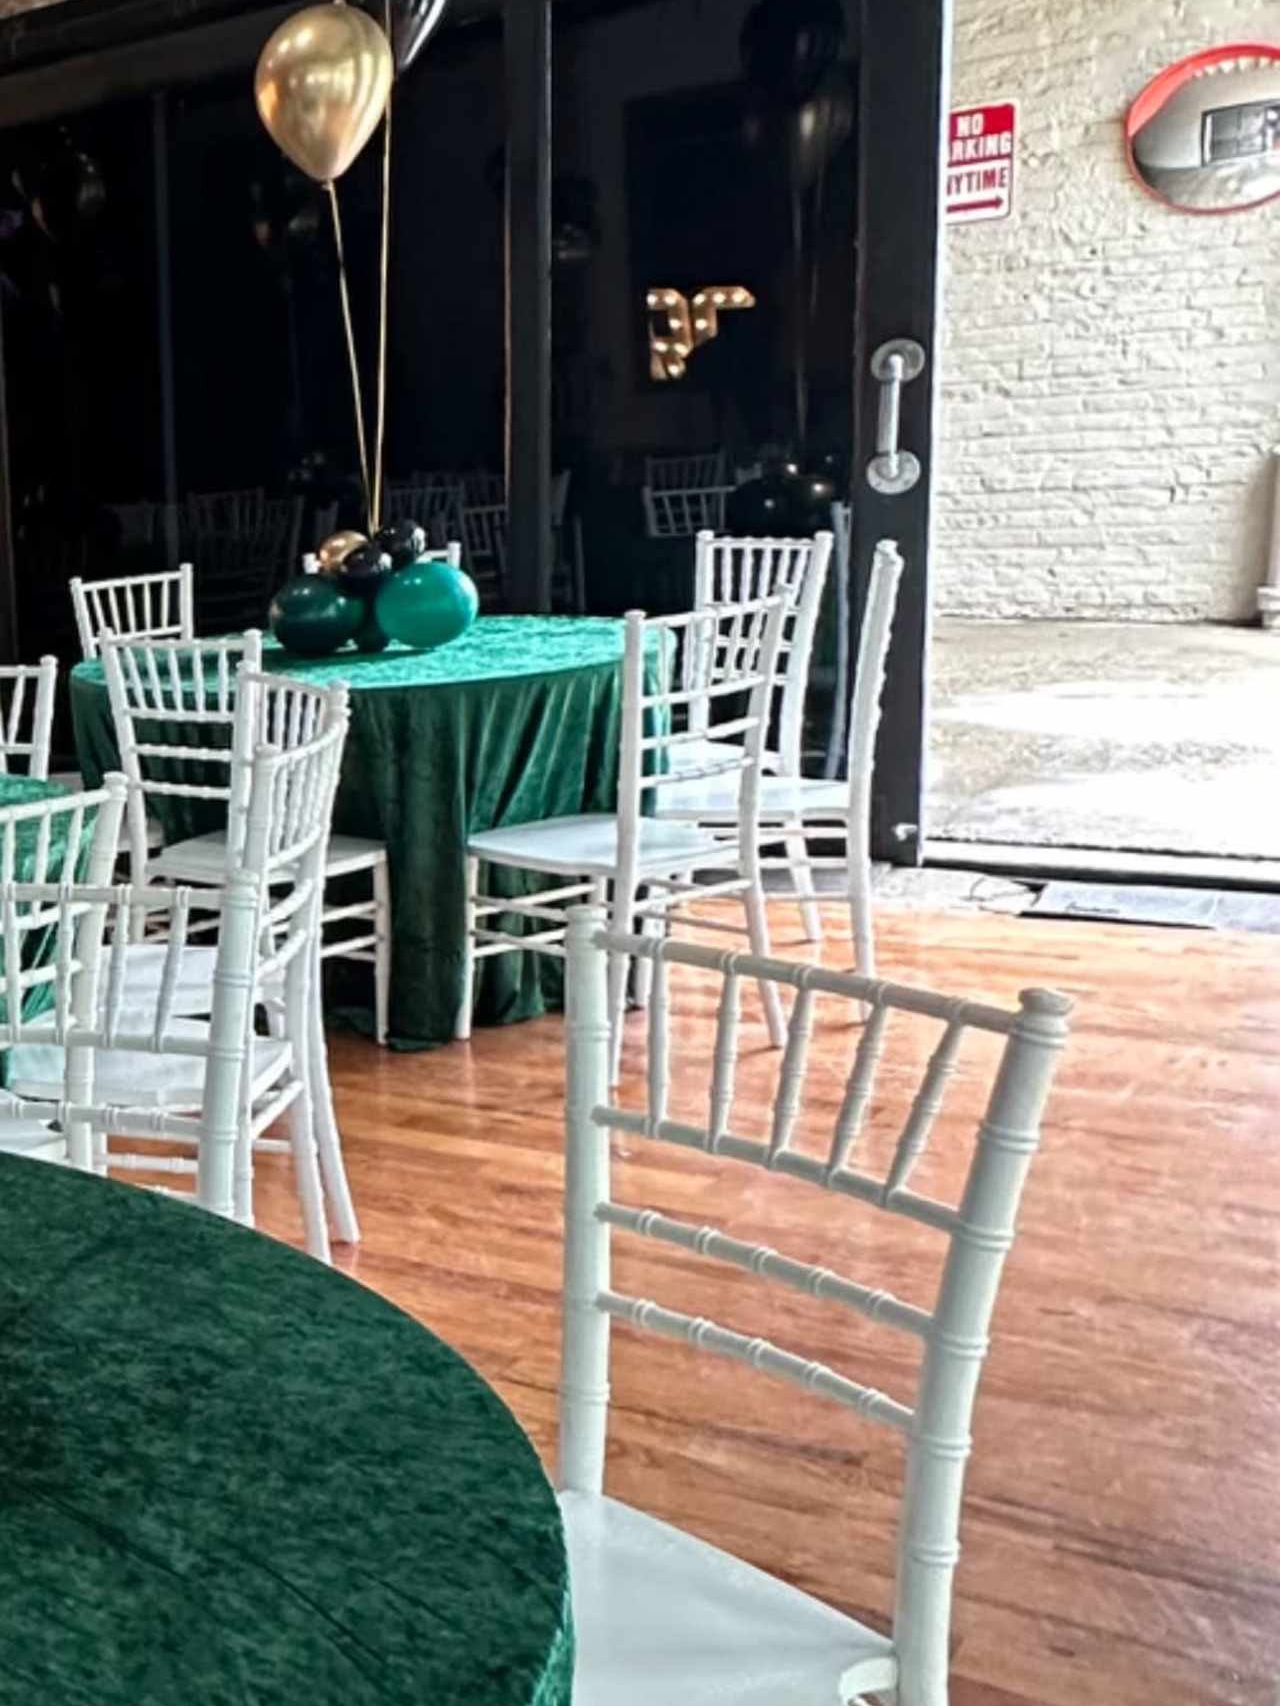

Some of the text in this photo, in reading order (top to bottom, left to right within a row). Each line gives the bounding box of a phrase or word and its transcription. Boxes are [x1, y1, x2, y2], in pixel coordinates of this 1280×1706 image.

[956, 113, 984, 137] NO
[951, 131, 1011, 161] RKING
[947, 167, 1007, 195] YTIME
